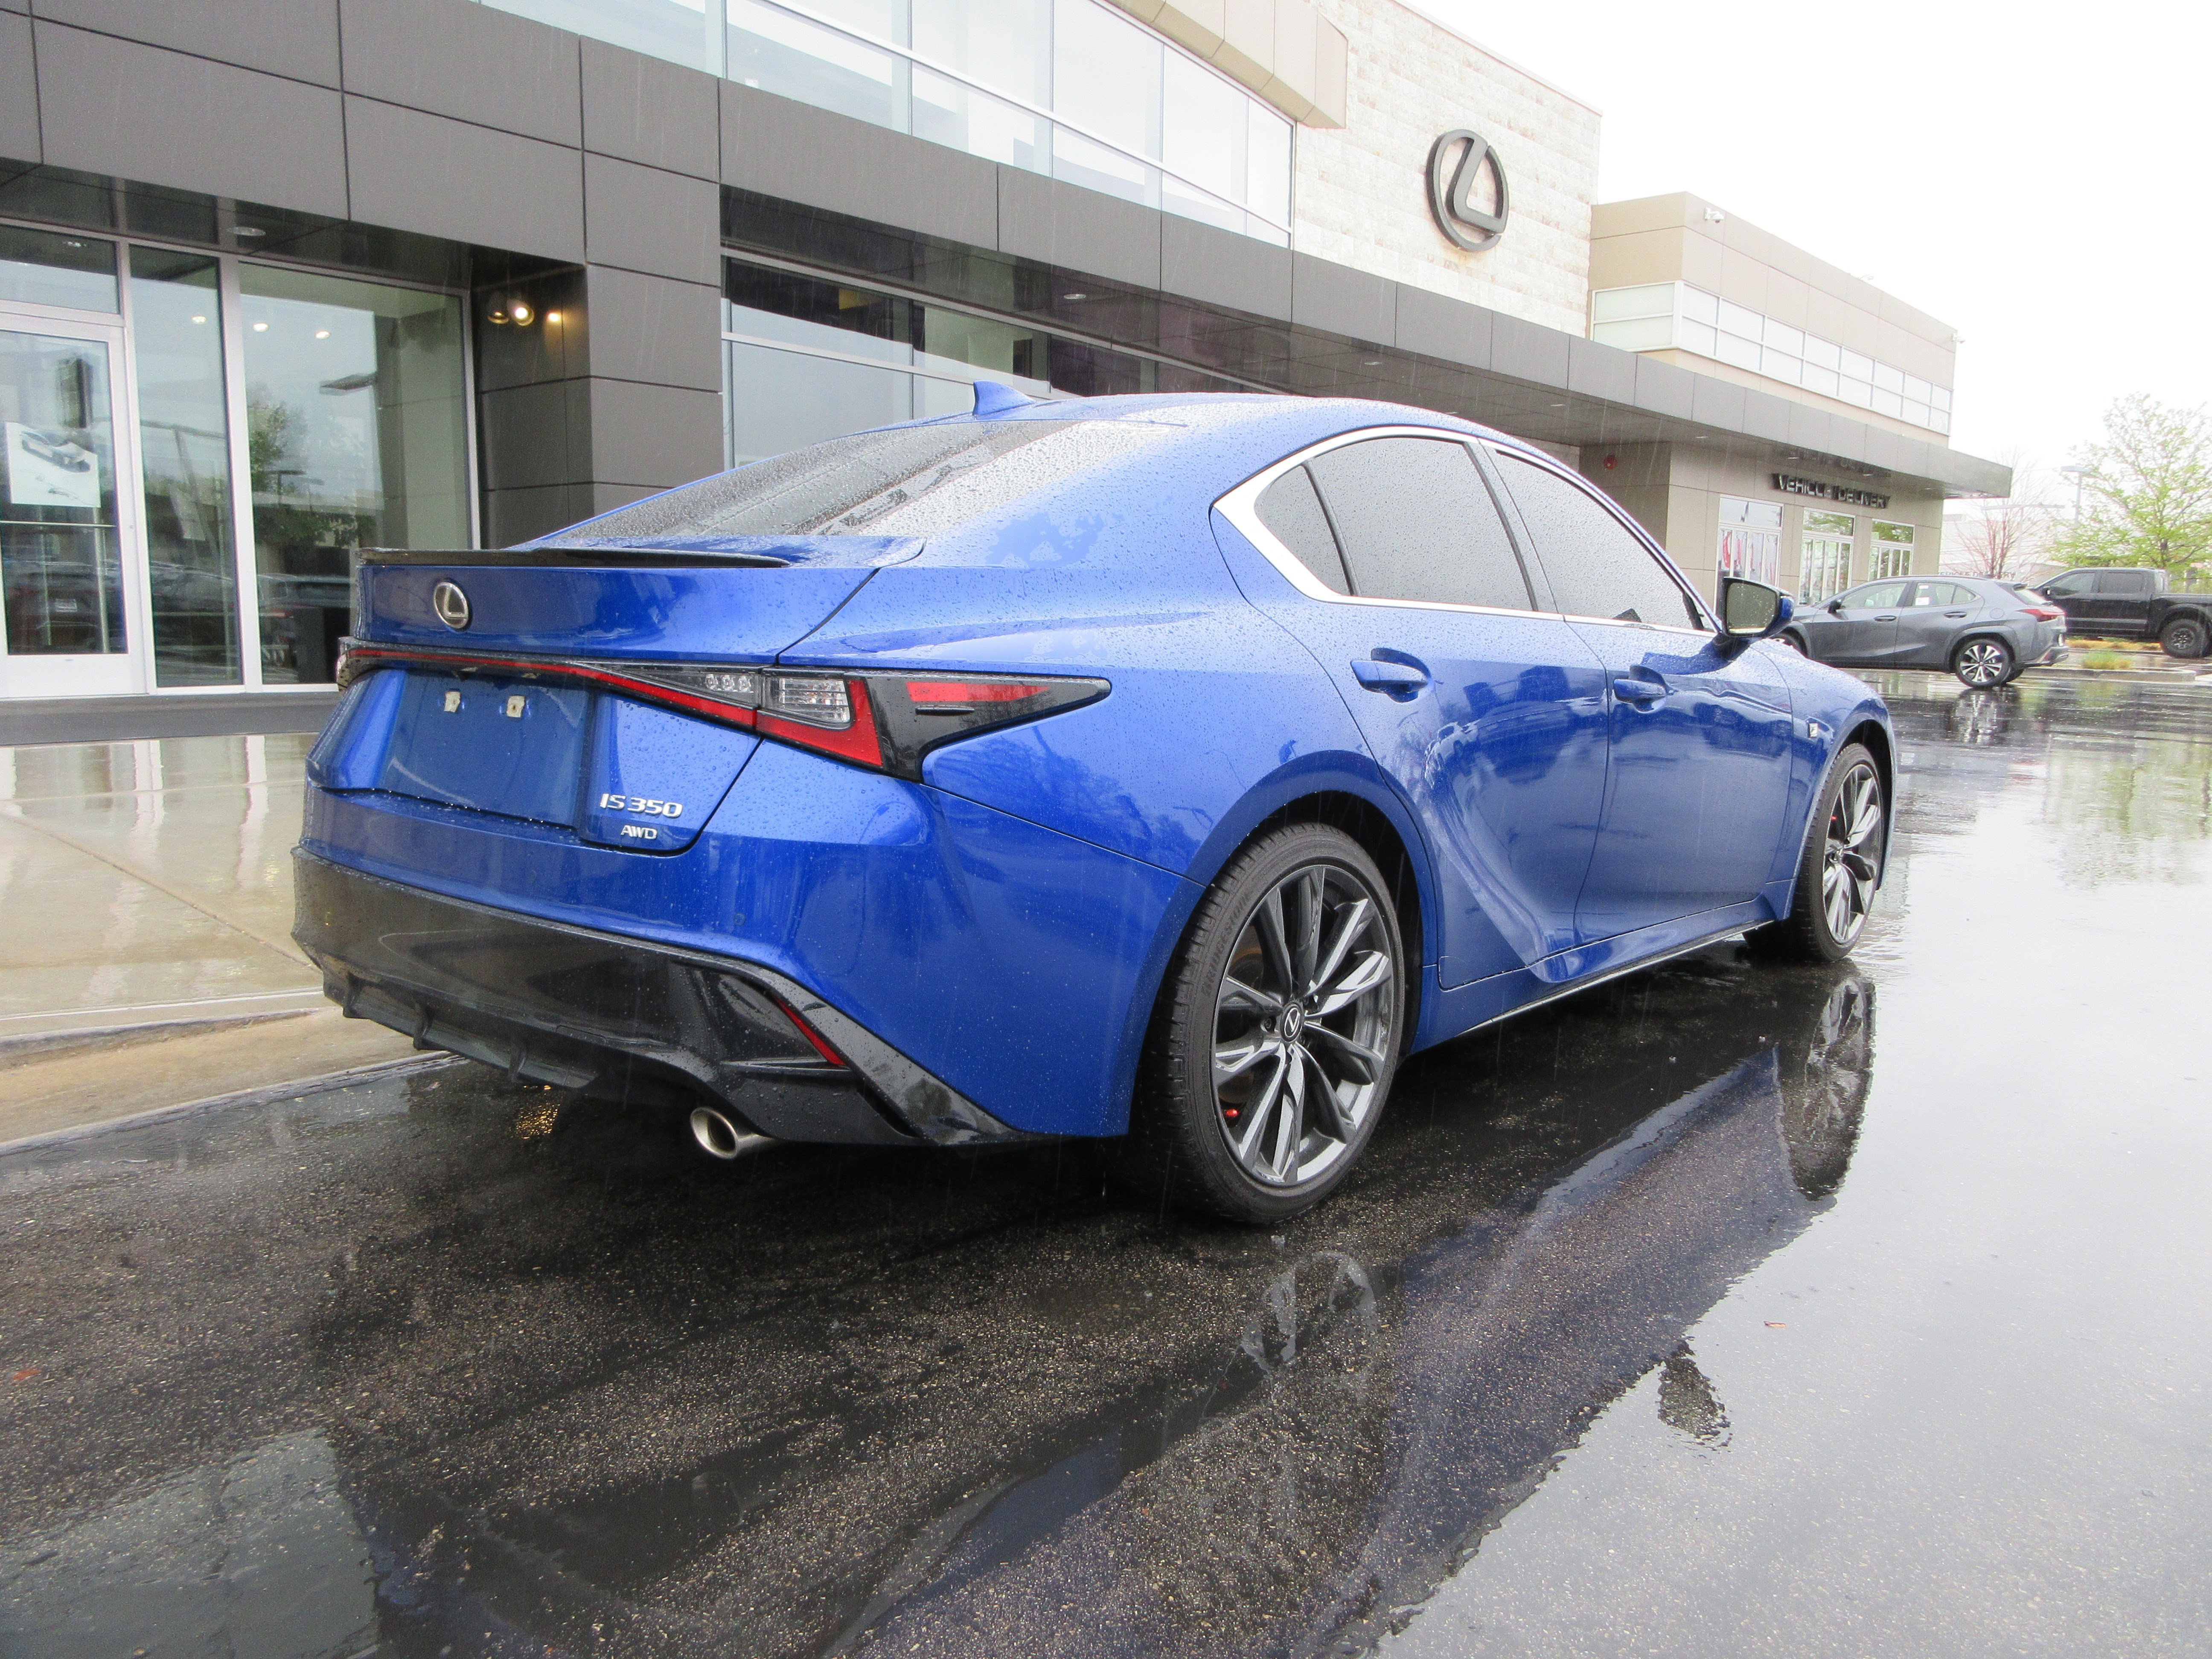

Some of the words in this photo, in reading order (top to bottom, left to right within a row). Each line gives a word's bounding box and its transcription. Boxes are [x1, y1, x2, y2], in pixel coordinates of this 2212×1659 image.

[600, 793, 626, 809] IS
[627, 797, 683, 818] 350
[620, 824, 658, 840] AWD
